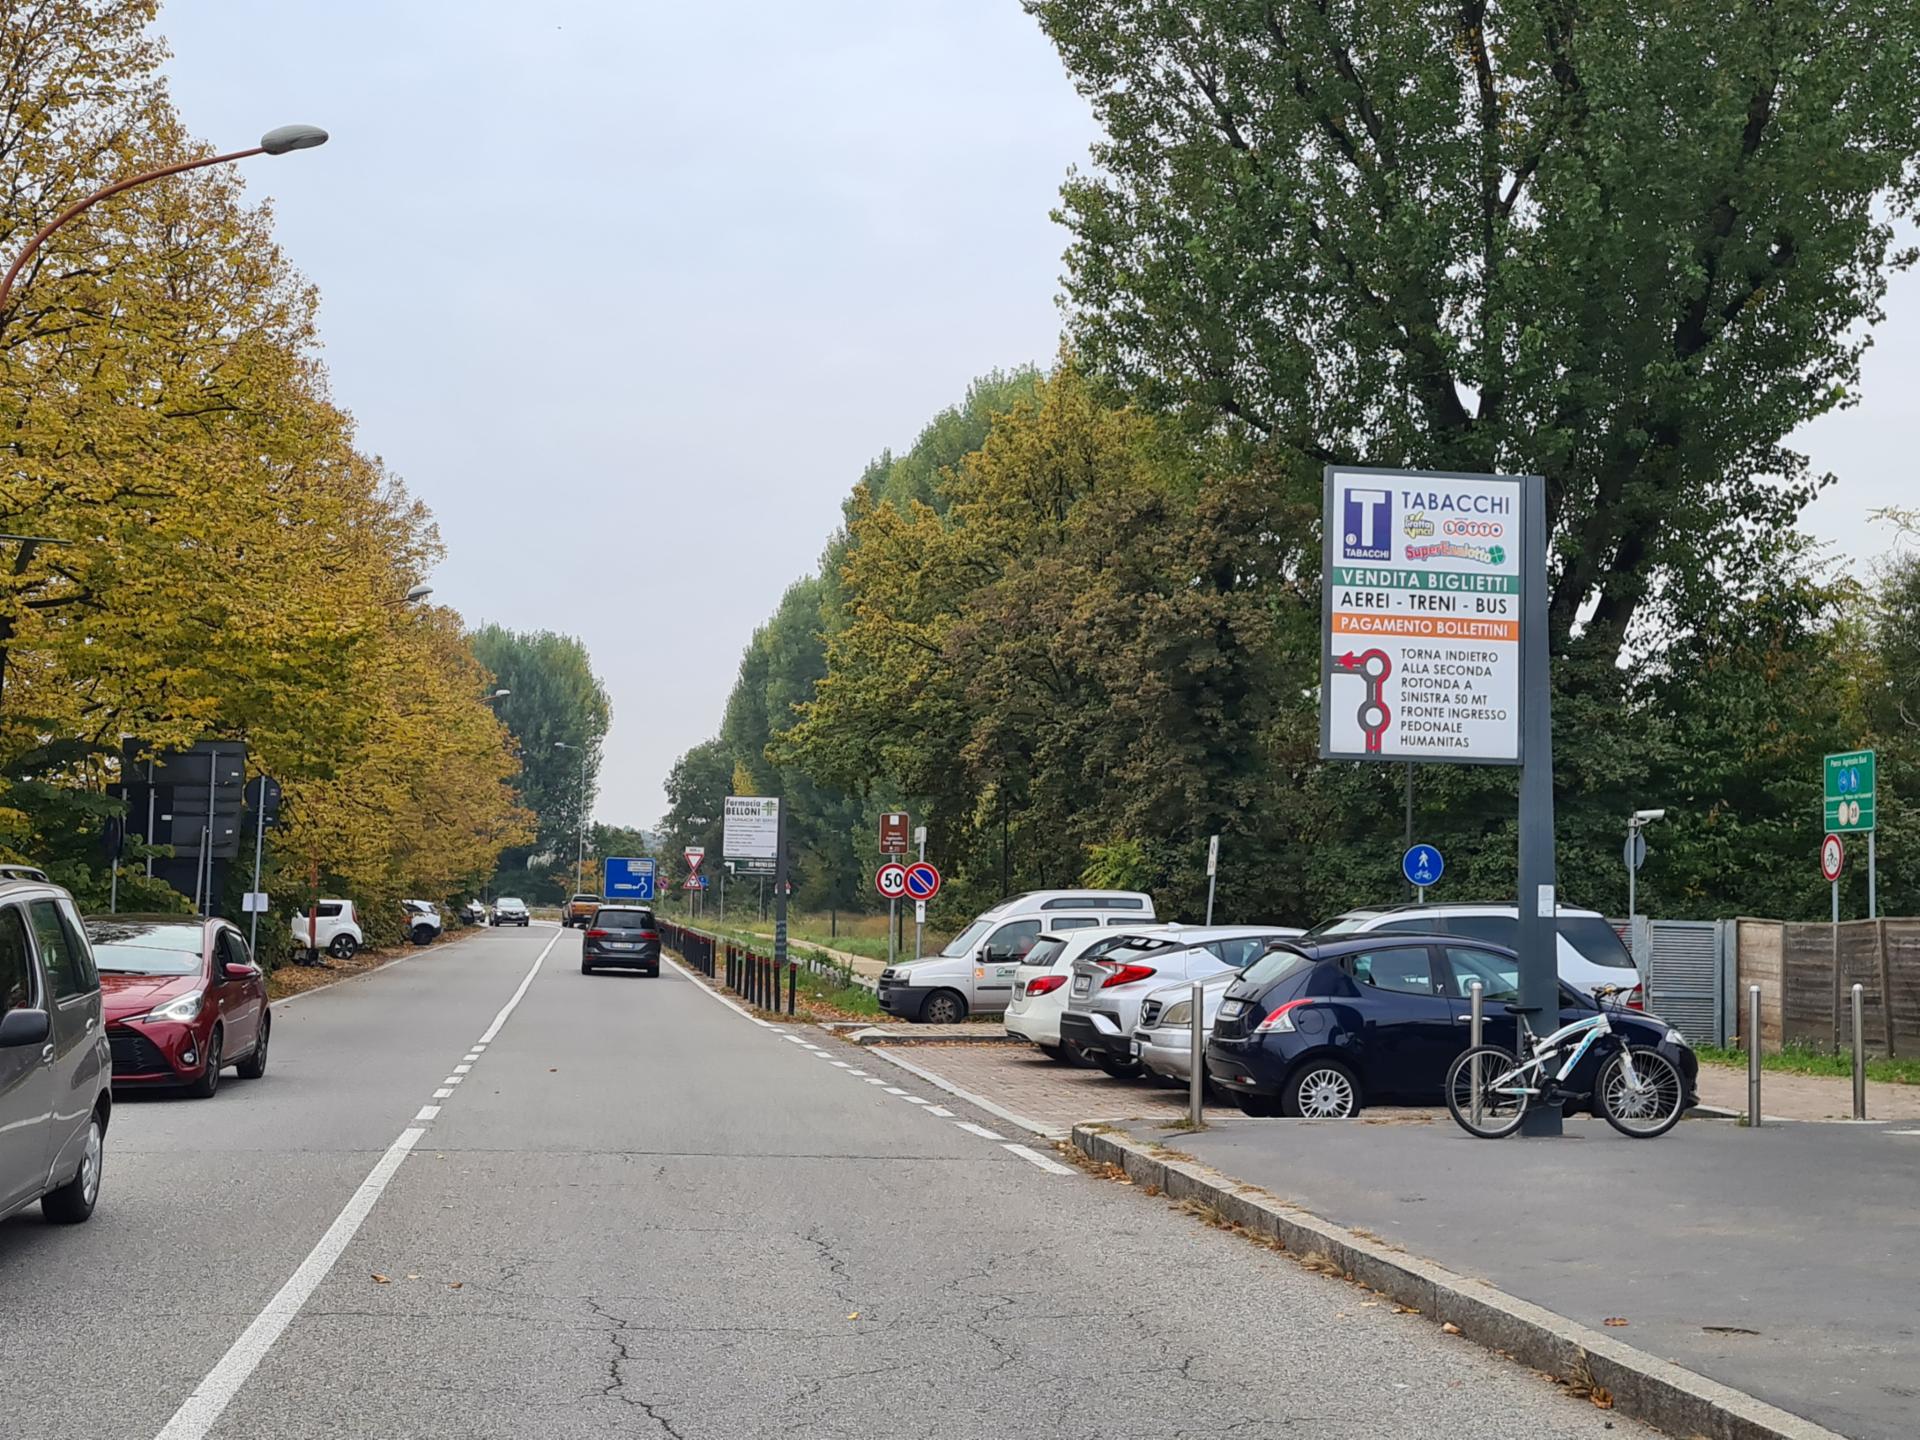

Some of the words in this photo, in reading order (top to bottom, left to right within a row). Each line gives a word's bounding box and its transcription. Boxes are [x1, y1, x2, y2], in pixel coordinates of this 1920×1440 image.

[1402, 491, 1509, 514] TABACCHI
[1350, 490, 1385, 547] T
[1443, 520, 1503, 538] LOTTO
[1345, 548, 1389, 559] TABACCHI
[1342, 569, 1420, 588] VENDITA
[1428, 574, 1508, 592] BIGLIETTI
[1341, 591, 1390, 608] AEREI
[1409, 594, 1456, 611] TRENI
[1476, 597, 1507, 614] BUS
[1341, 616, 1433, 634] PAGAMENTO
[1436, 621, 1508, 637] BOLLETTINI
[1401, 648, 1441, 661] TORNA
[1445, 650, 1498, 663] INDIETRO
[1401, 663, 1430, 674] ALLA
[1433, 664, 1492, 677] SECONDA
[1401, 677, 1460, 690] ROTONDA
[1464, 680, 1472, 690] A
[1401, 691, 1450, 704] SINISTRA
[1454, 694, 1468, 705] 50
[1471, 695, 1487, 706] MT
[1401, 706, 1445, 719] FRONTE
[1448, 708, 1507, 721] INGRESSO
[1400, 720, 1463, 734] PEDONALE
[1400, 735, 1469, 749] HUMANITAS
[726, 799, 761, 807] Farmacia
[726, 807, 760, 816] BELLONI
[884, 873, 902, 888] 50
